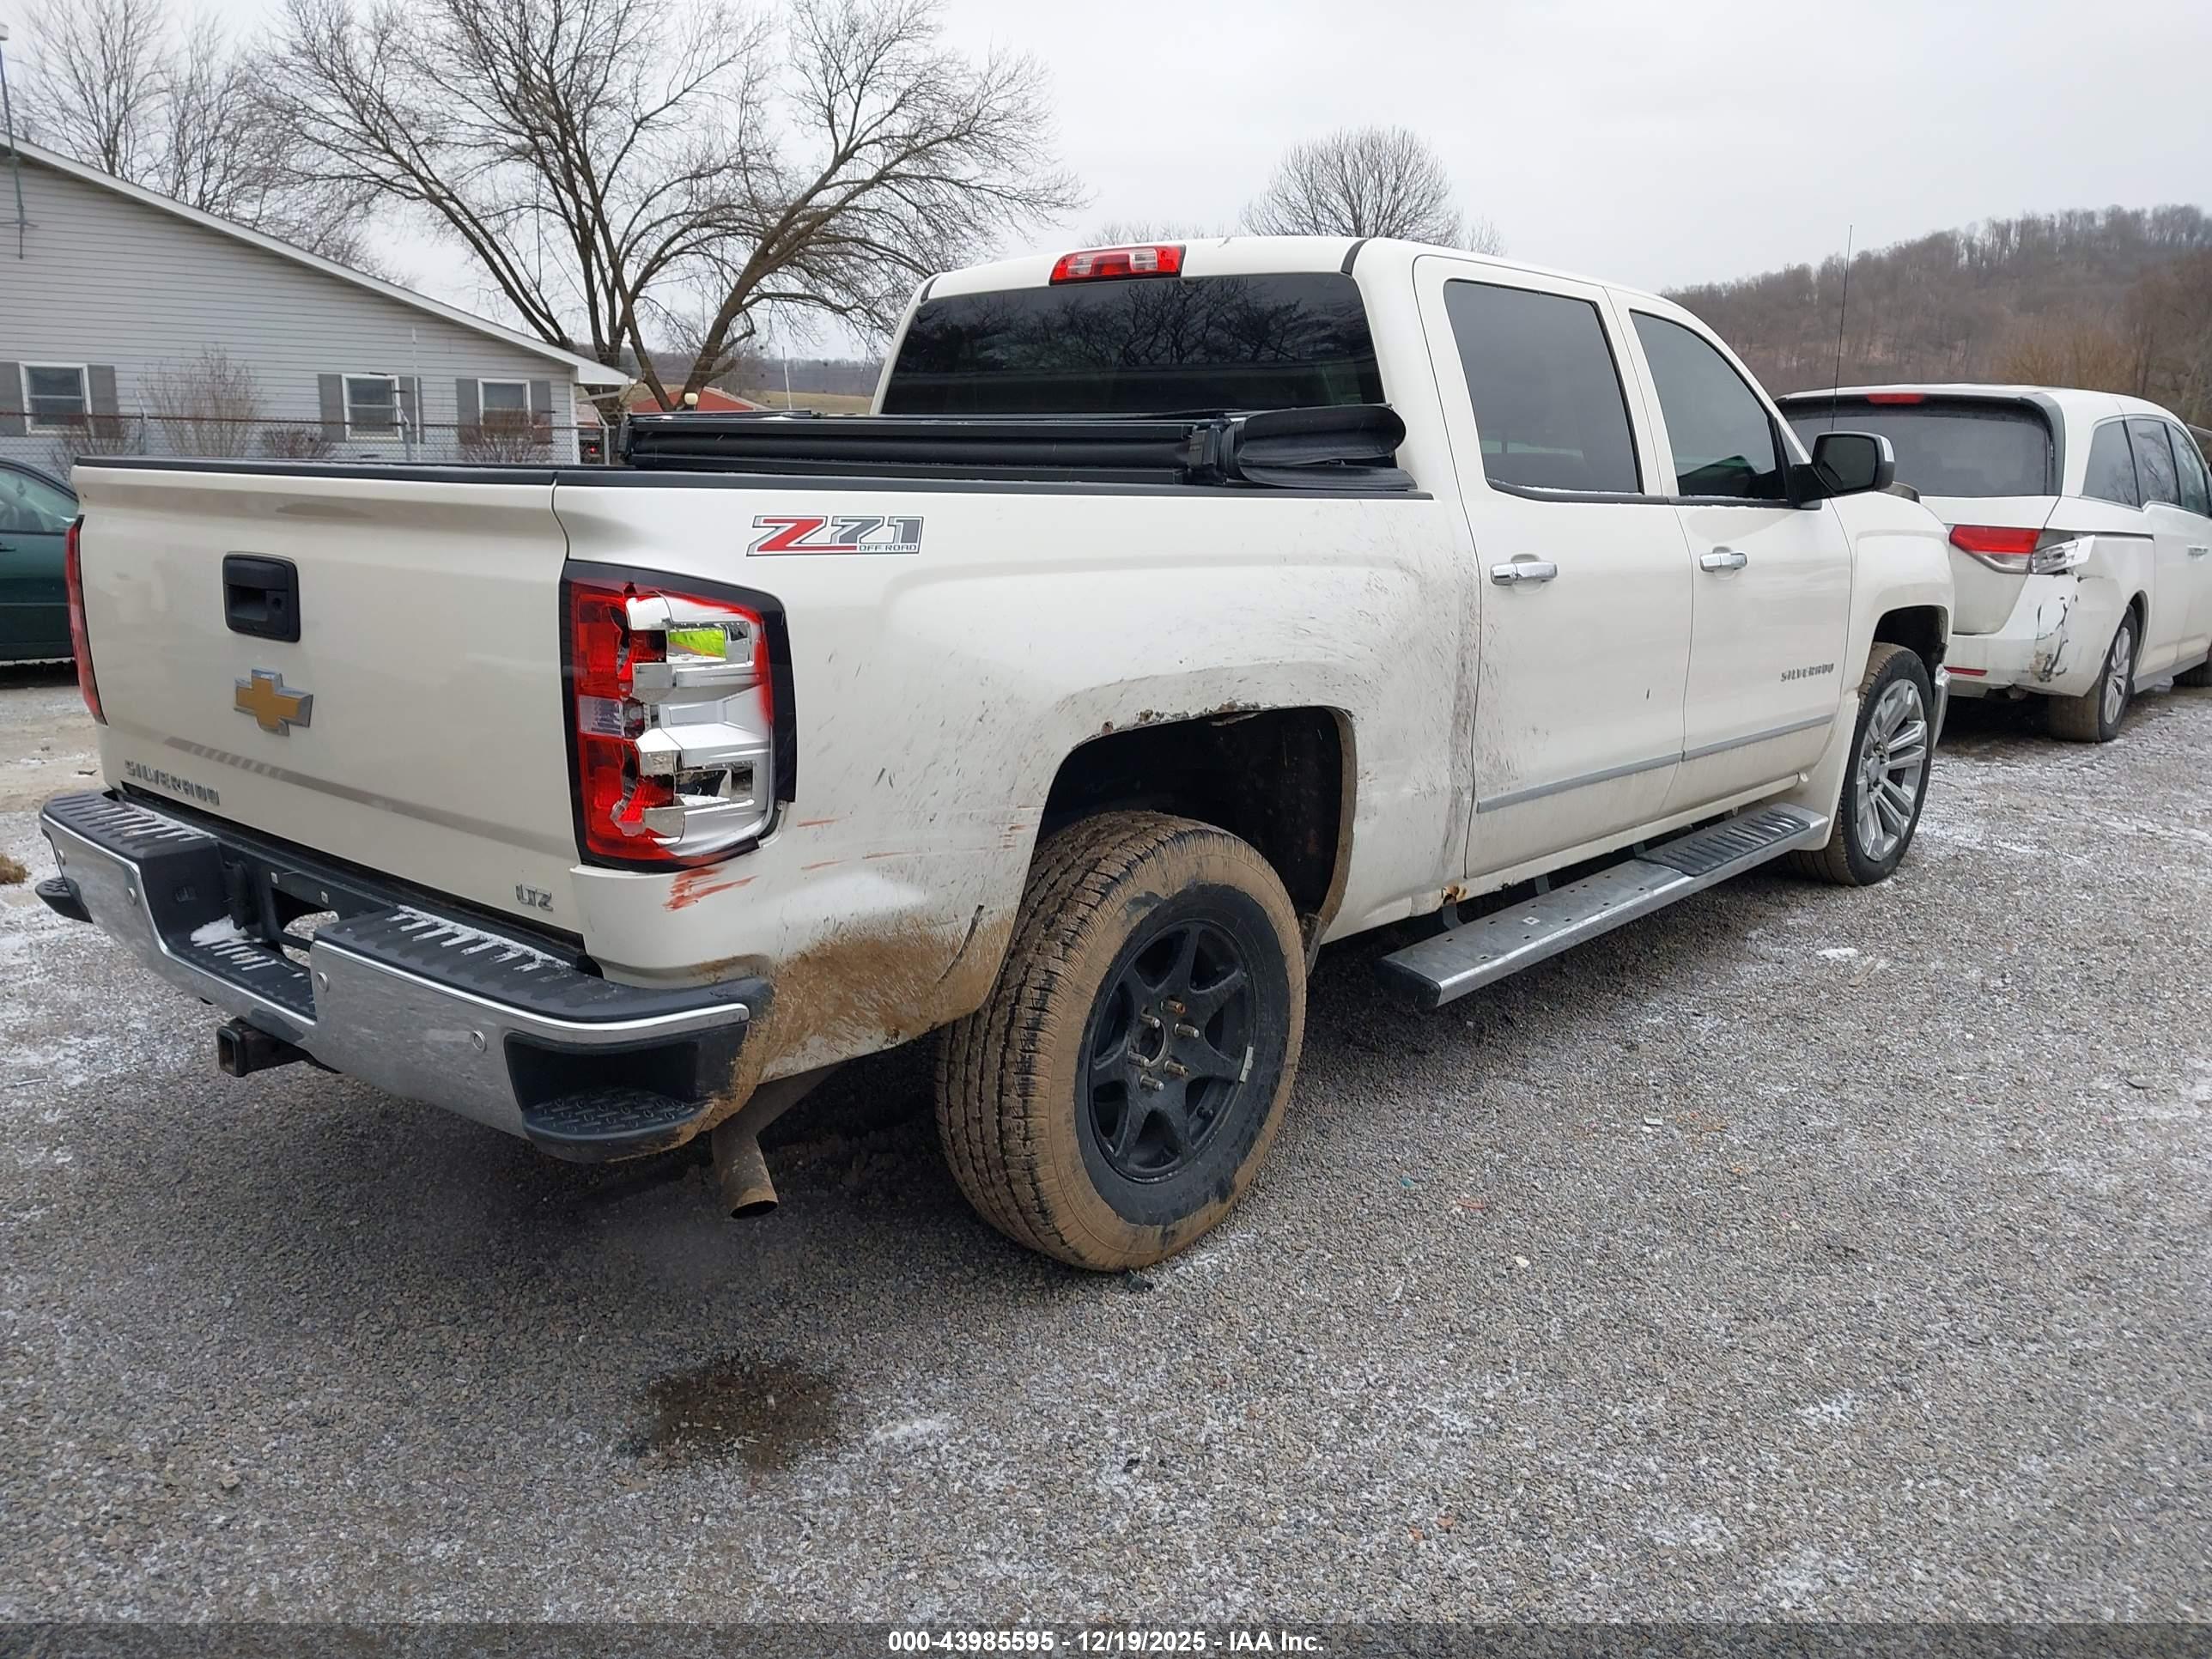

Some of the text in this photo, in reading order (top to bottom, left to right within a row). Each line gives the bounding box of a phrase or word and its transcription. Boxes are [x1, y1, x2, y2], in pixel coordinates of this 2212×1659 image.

[746, 515, 924, 556] Z71
[859, 544, 917, 552] OFF ROAD
[125, 759, 220, 806] SILVERADO
[514, 884, 555, 912] LTZ
